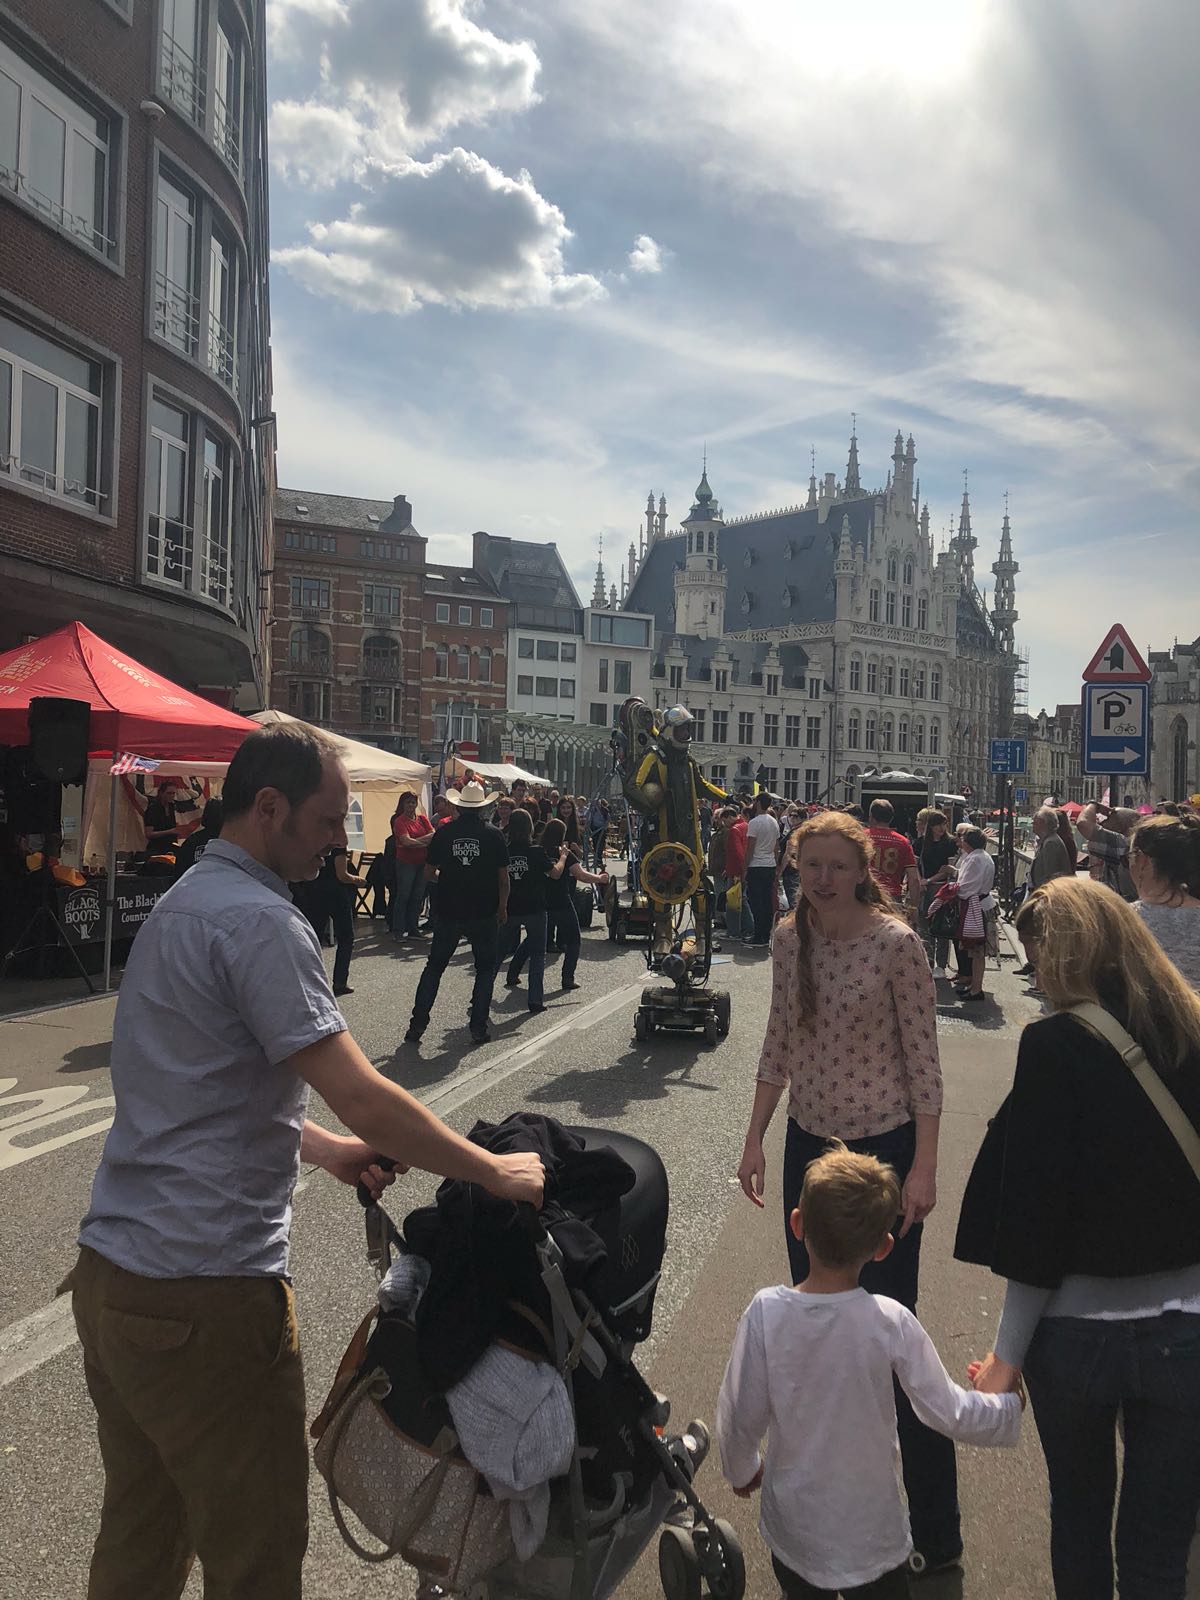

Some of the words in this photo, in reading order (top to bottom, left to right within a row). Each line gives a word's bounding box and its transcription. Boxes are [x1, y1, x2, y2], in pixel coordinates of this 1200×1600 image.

[1104, 701, 1125, 729] P
[452, 843, 480, 851] BLACK
[453, 849, 480, 857] BOOTS
[64, 896, 101, 914] BLACK
[117, 896, 134, 909] The
[65, 909, 101, 925] BOOTS
